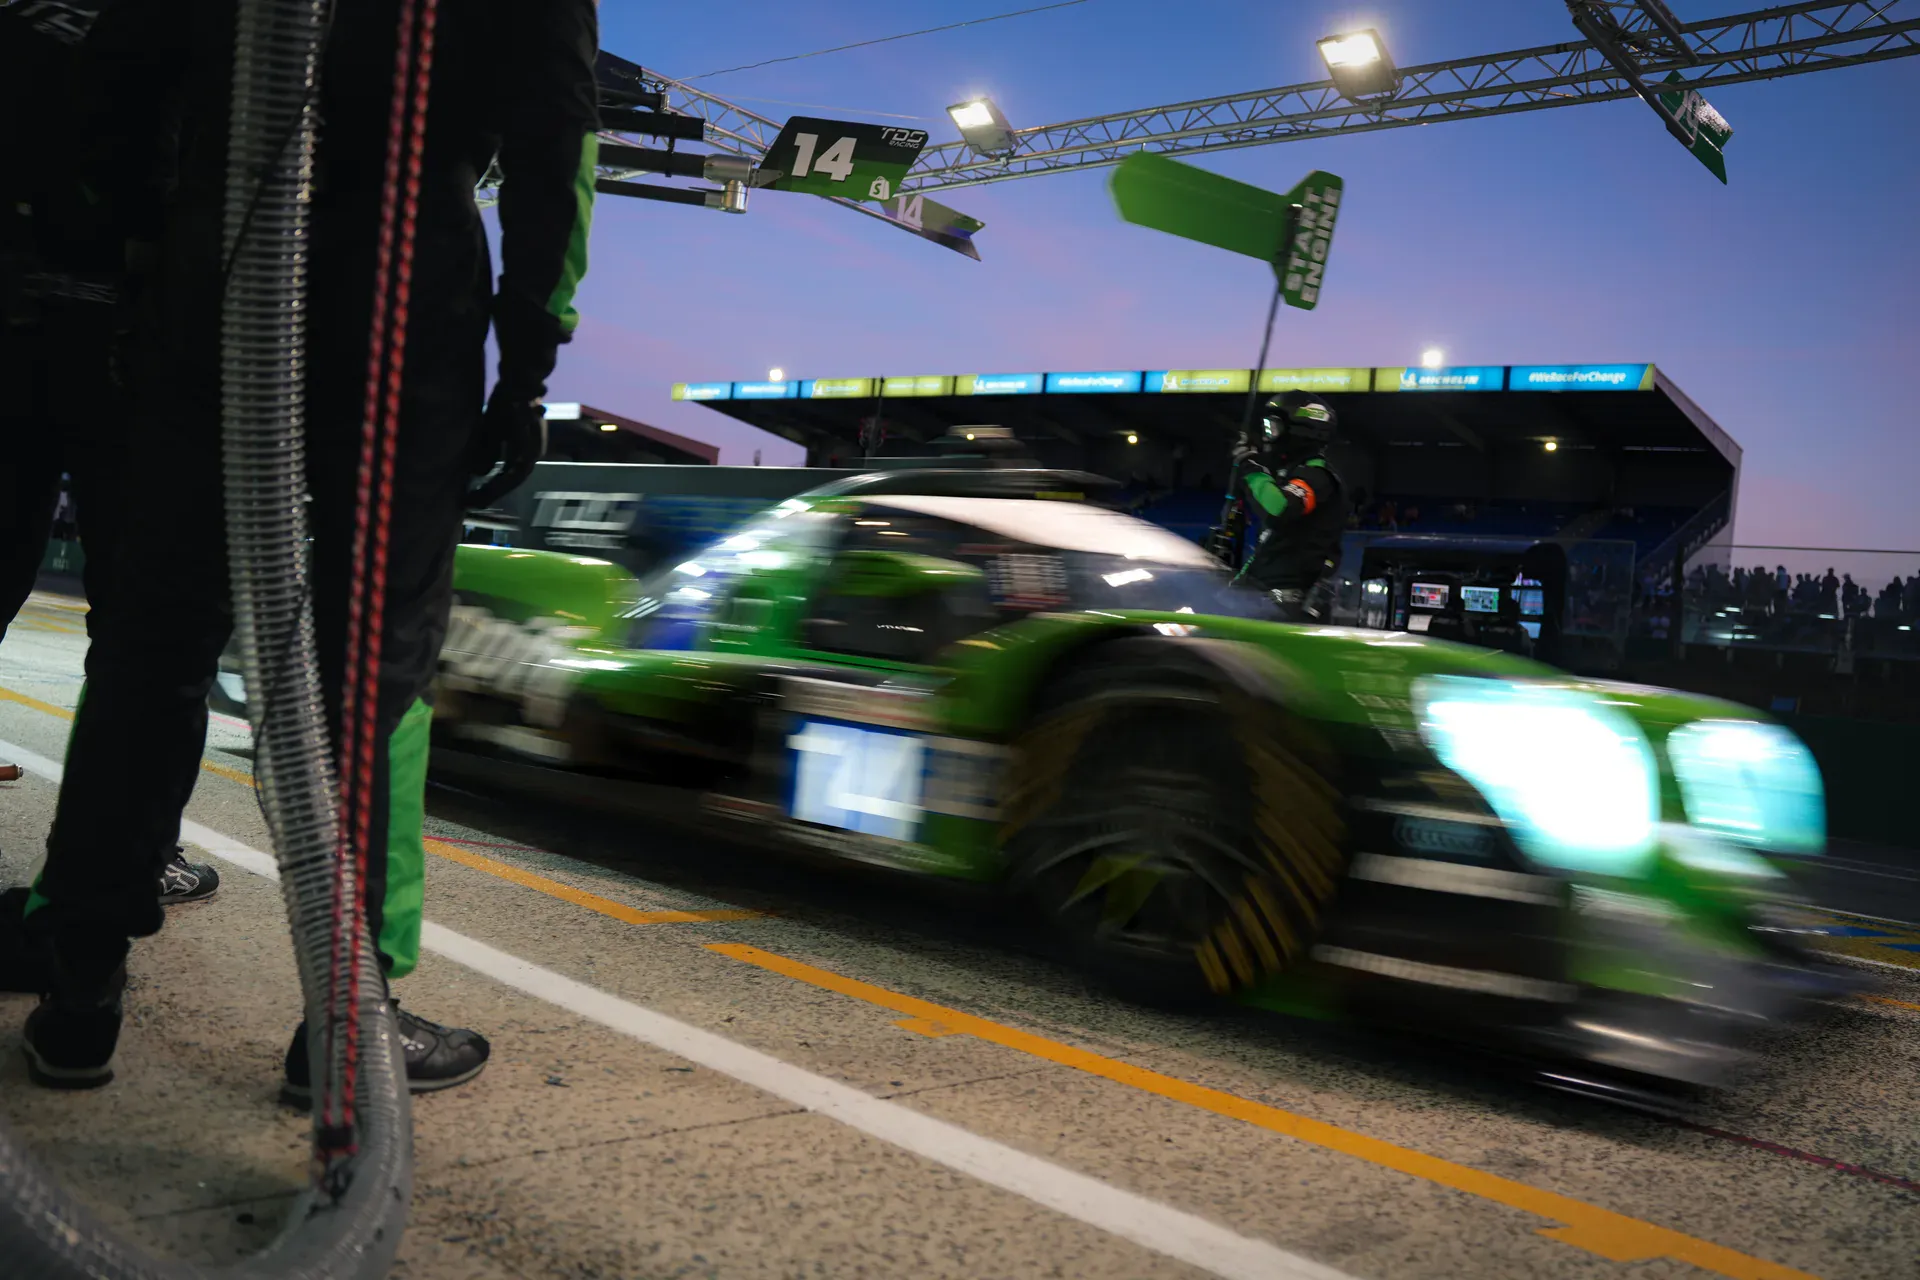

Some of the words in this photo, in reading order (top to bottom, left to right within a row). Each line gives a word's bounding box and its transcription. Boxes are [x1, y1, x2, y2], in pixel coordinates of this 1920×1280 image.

[881, 127, 926, 143] TDS
[888, 140, 920, 149] RACING
[791, 132, 858, 181] 14
[896, 195, 924, 229] 14
[1285, 186, 1322, 292] START
[1301, 186, 1341, 304] ENGINE
[1418, 375, 1480, 386] MICHELIN
[1528, 371, 1627, 385] #WeRaceForChange
